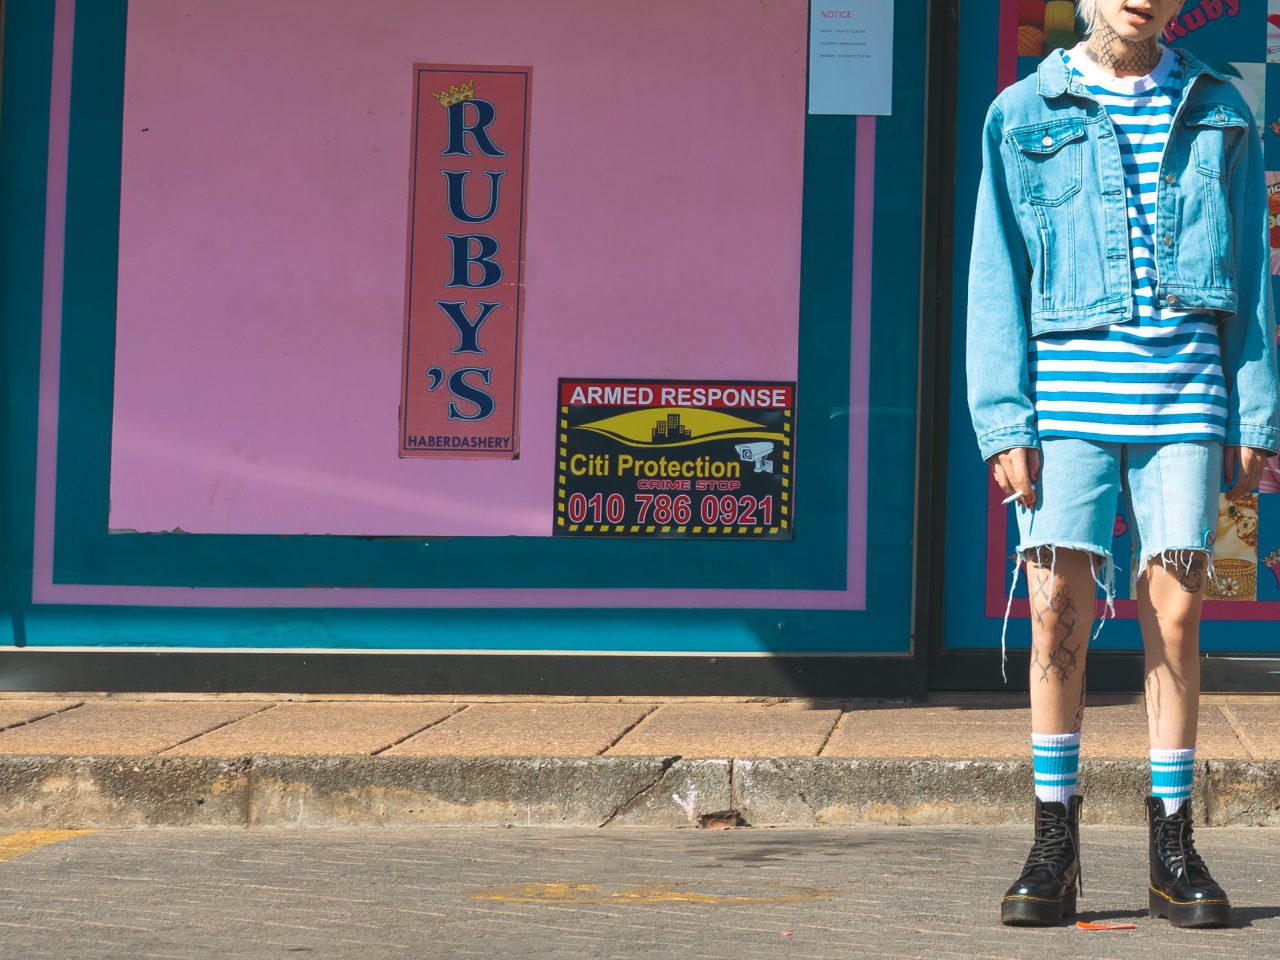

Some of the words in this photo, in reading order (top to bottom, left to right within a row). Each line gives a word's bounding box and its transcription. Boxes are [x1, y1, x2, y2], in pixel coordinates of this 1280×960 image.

[821, 10, 852, 19] NOTICE
[425, 98, 508, 422] RUBY'S
[570, 386, 654, 405] ARMED
[661, 388, 786, 407] RESPONSE
[408, 435, 511, 449] HABERDASHERY
[570, 453, 610, 476] Citi
[618, 454, 740, 478] Protection
[637, 479, 691, 491] CRIME
[695, 480, 741, 491] STOP
[568, 492, 625, 523] 010
[634, 493, 692, 524] 786
[700, 494, 773, 525] 0921
